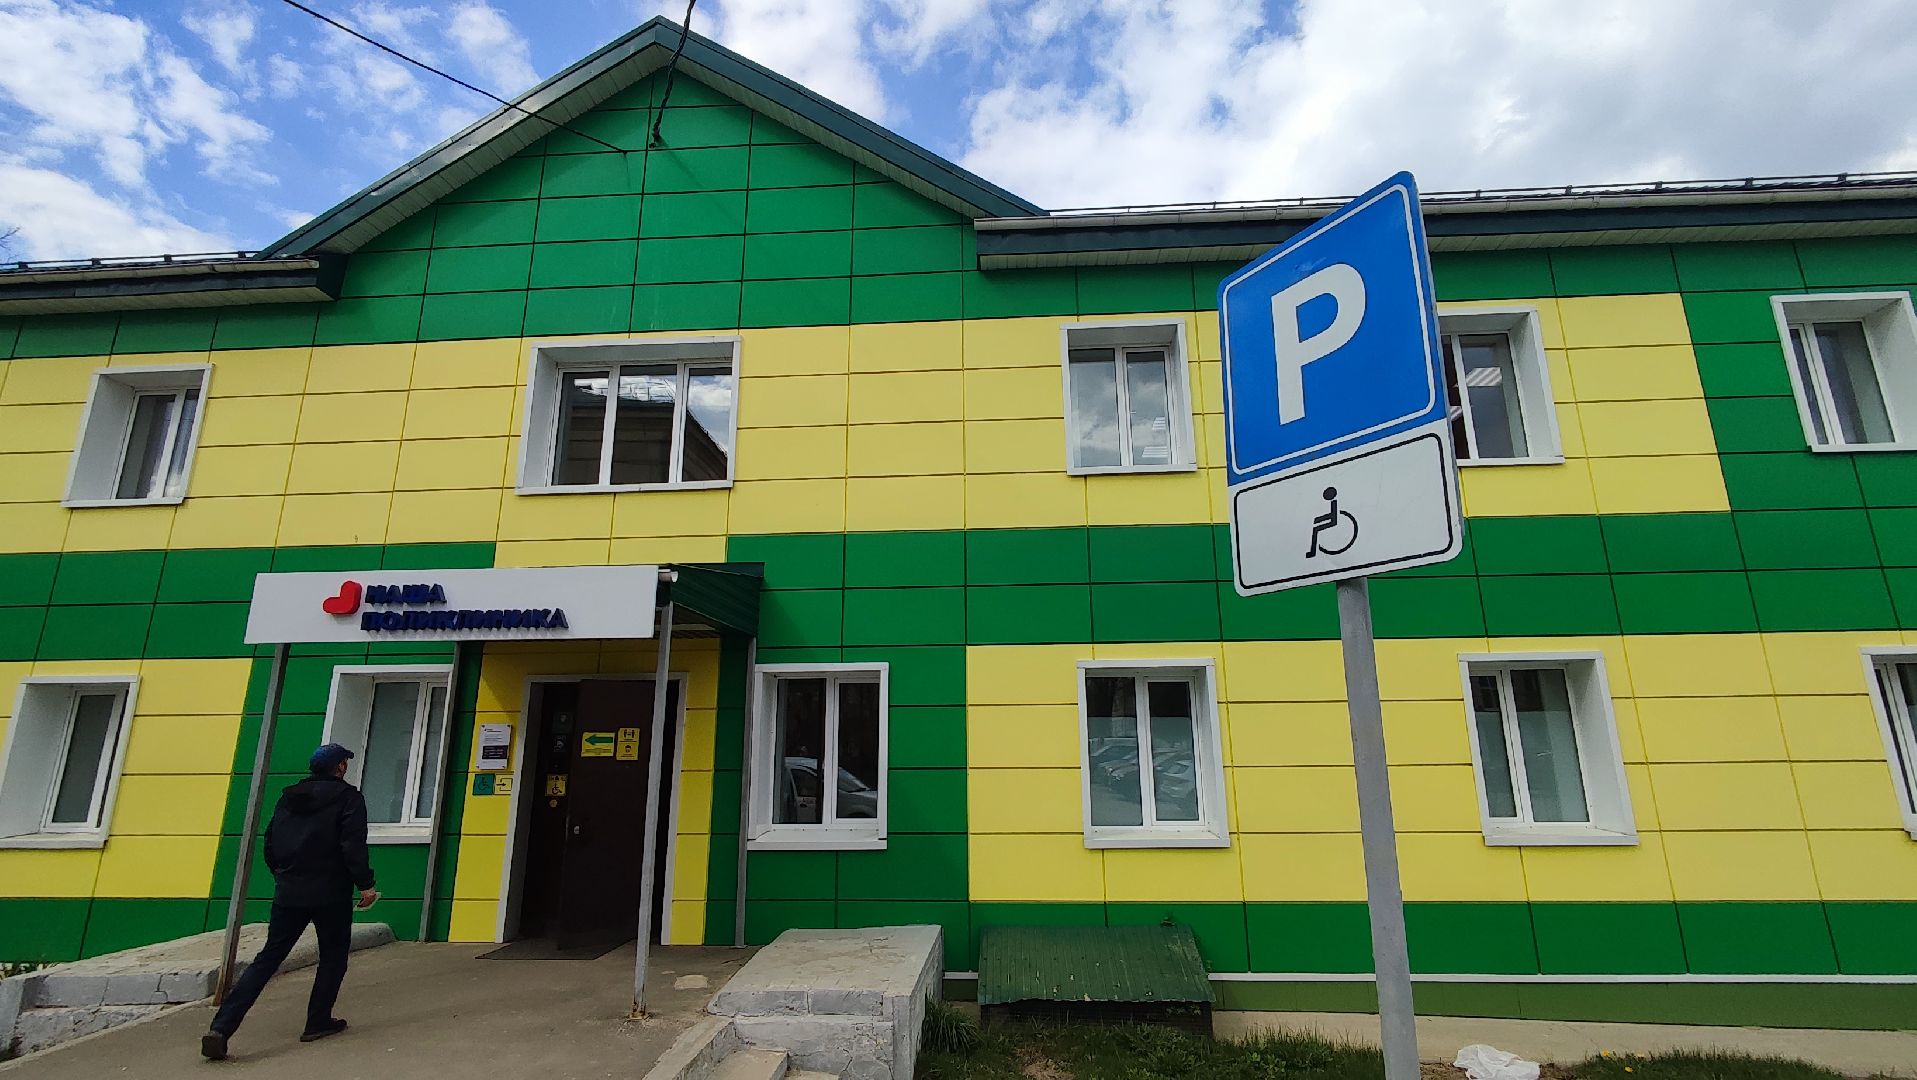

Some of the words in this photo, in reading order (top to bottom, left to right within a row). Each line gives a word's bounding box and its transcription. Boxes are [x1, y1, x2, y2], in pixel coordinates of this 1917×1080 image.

[1271, 263, 1366, 426] P
[365, 584, 447, 604] НАША
[361, 608, 569, 632] ПОЛИКЛИНИКА
